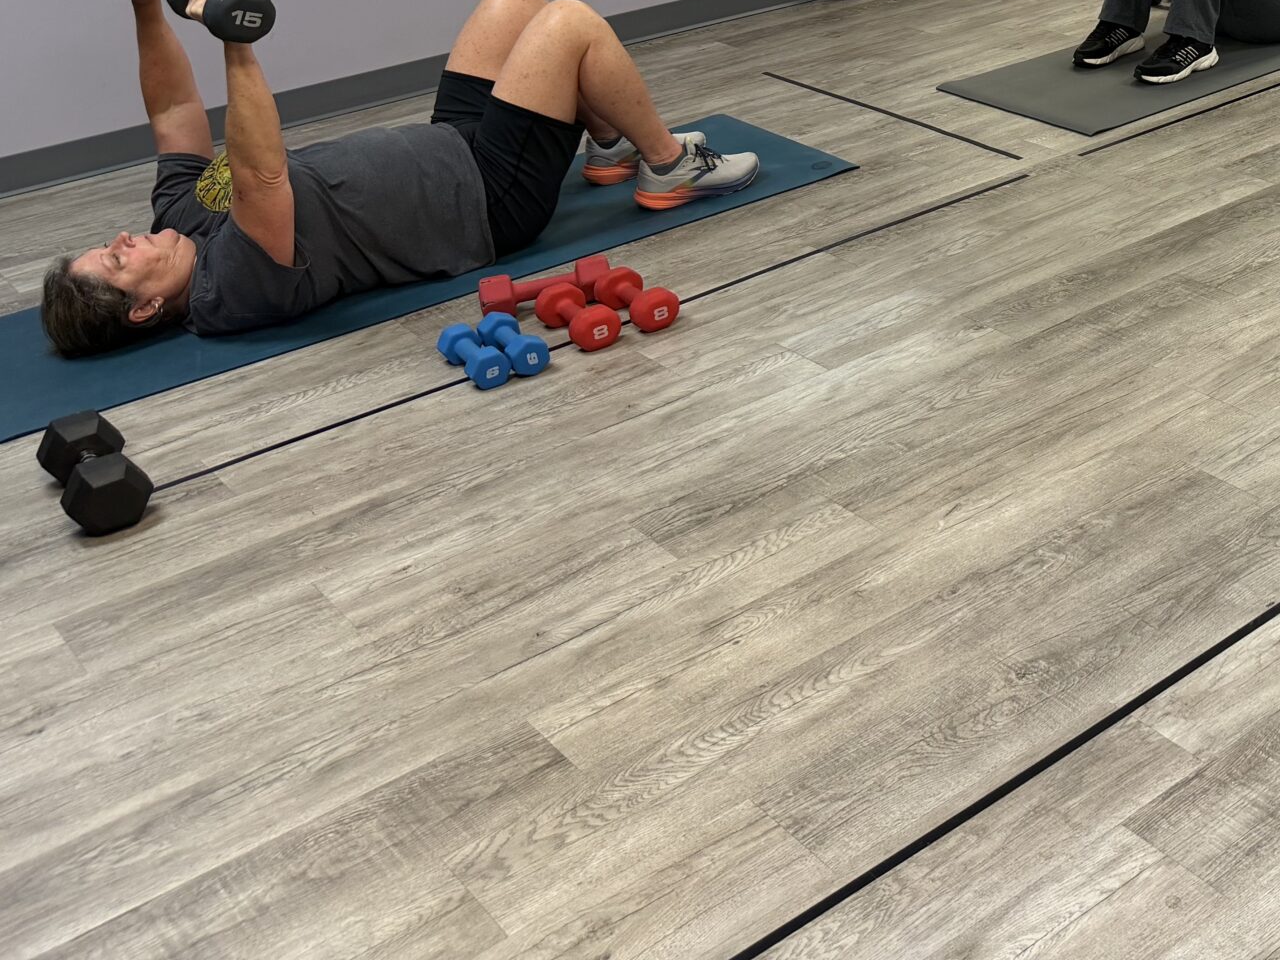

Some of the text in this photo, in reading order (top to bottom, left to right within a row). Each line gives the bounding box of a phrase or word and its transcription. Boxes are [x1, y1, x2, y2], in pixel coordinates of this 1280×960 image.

[231, 9, 264, 28] 15
[653, 305, 669, 321] 8
[592, 324, 609, 340] 8
